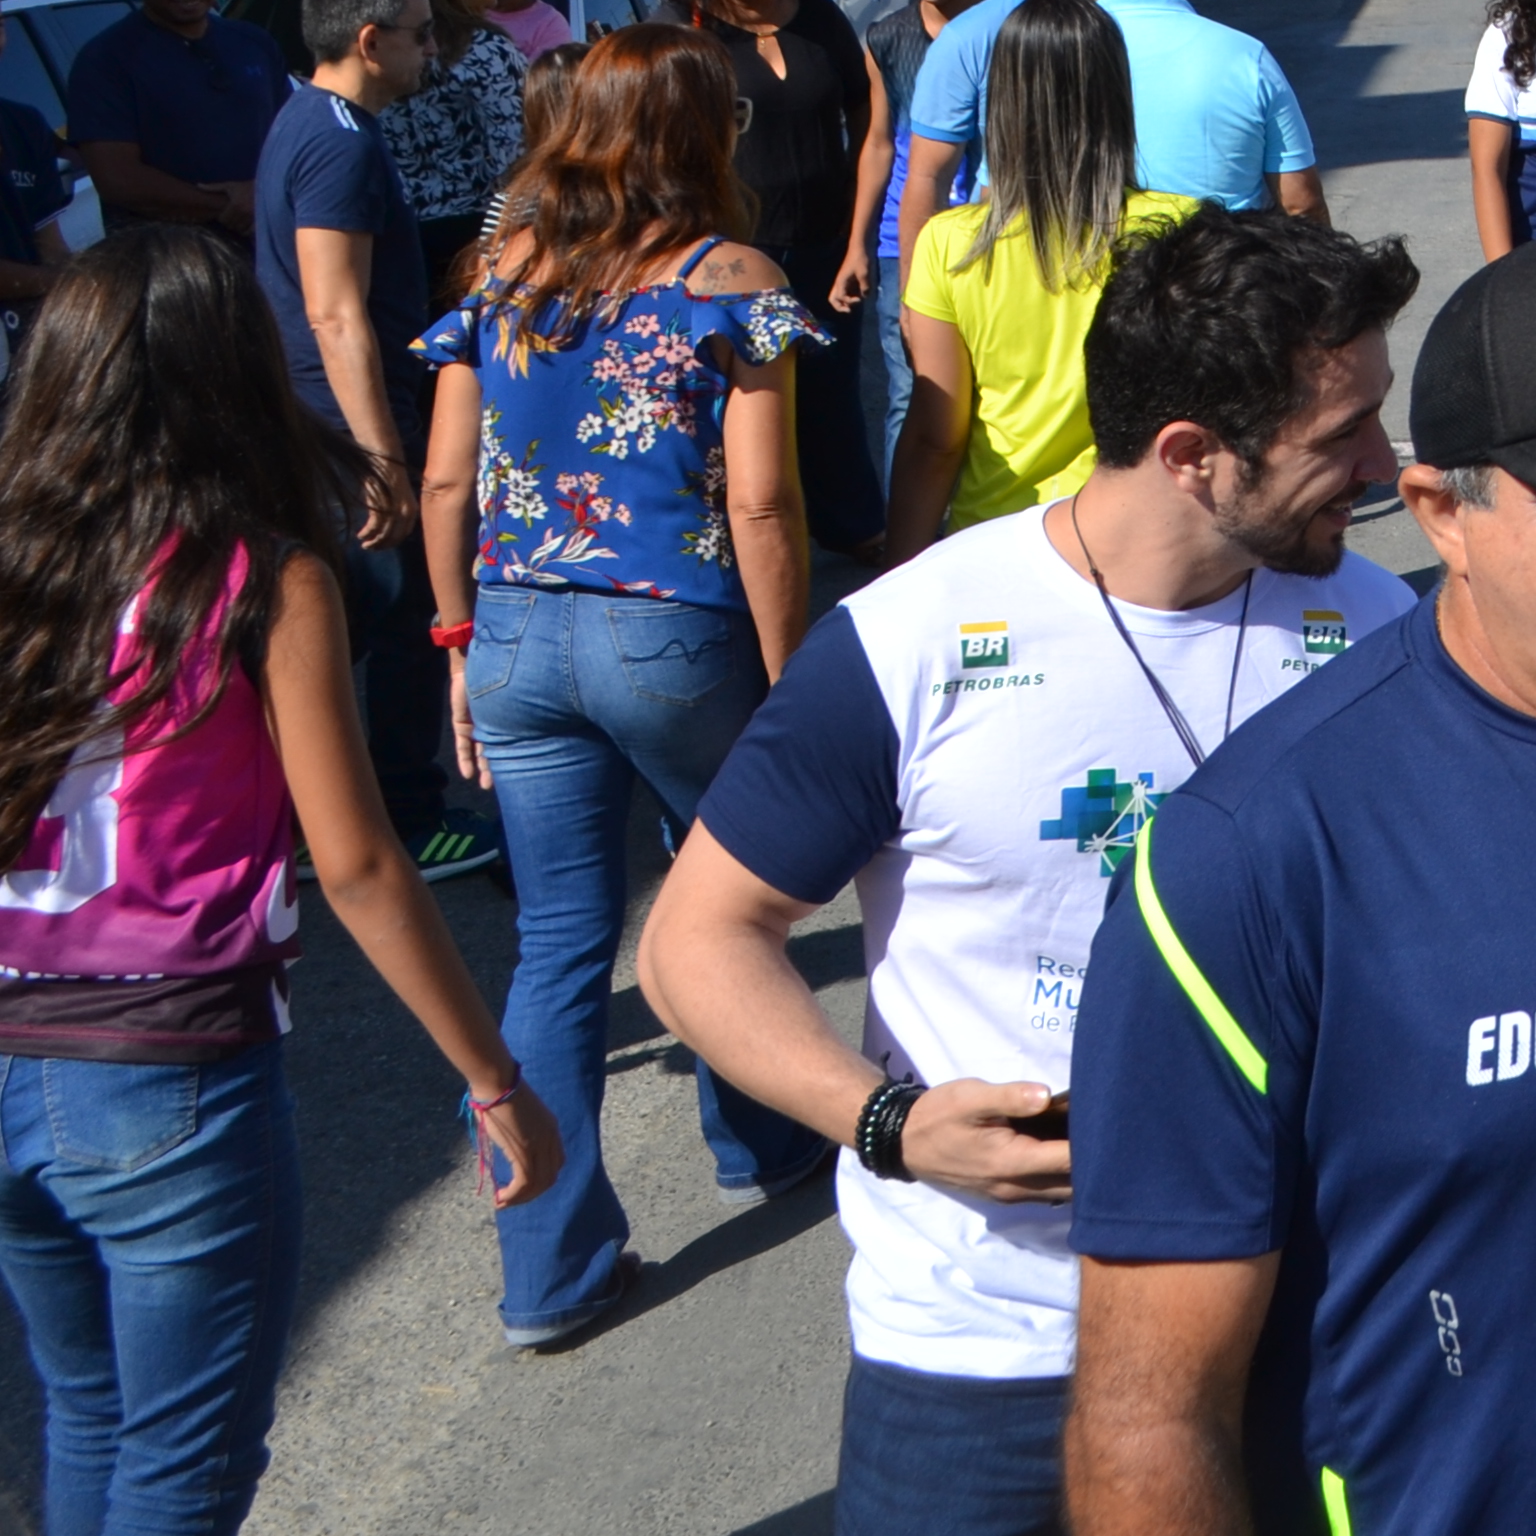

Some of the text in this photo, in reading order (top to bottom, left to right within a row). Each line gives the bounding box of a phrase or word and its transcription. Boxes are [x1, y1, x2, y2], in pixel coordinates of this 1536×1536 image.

[1306, 624, 1342, 644] BR
[965, 636, 1004, 657] BR
[932, 673, 1045, 696] PETROBRAS
